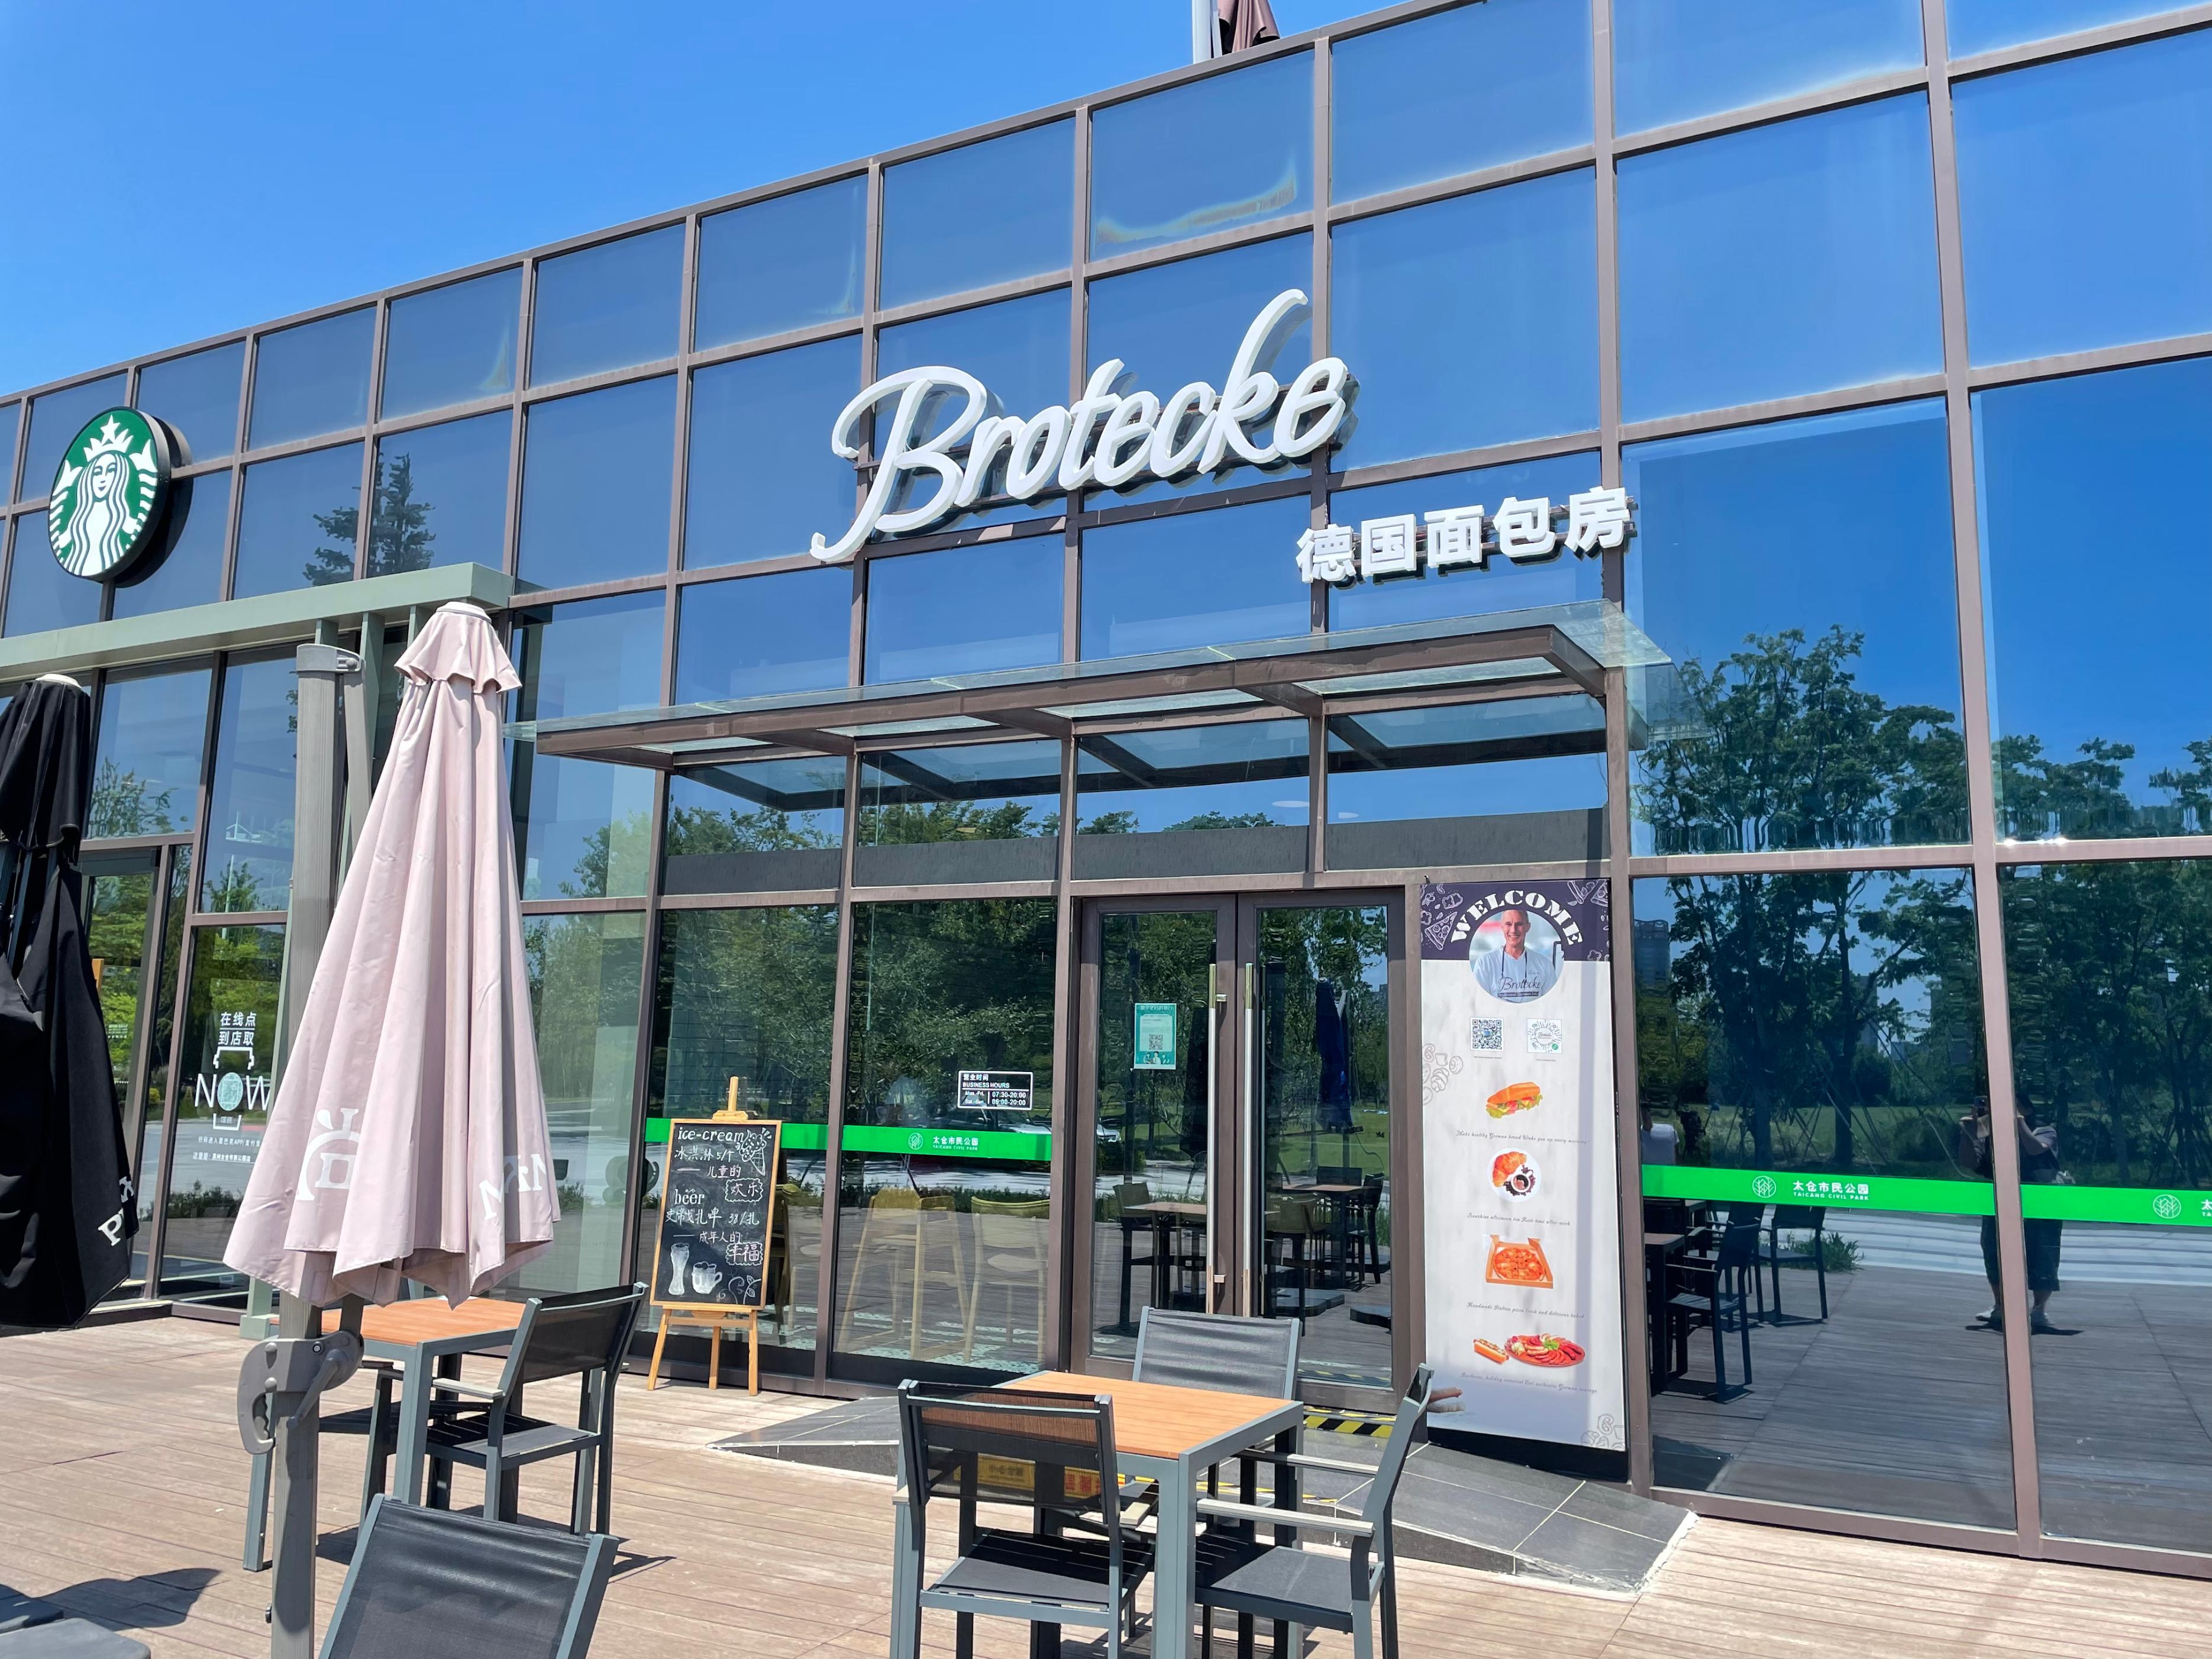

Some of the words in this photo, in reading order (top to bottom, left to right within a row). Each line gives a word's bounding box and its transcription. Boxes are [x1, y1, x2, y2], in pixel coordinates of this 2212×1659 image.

[810, 288, 1348, 562] Brotecke
[1296, 486, 1631, 583] 德国面包房
[1451, 889, 1584, 945] WELCOME
[220, 1011, 256, 1027] 在线点
[218, 1031, 254, 1045] 到店取
[677, 1127, 744, 1142] ice-cream
[933, 1136, 979, 1146] 太仓市民公园
[1793, 1180, 1869, 1195] 太仓市民公园
[674, 1189, 705, 1205] beer
